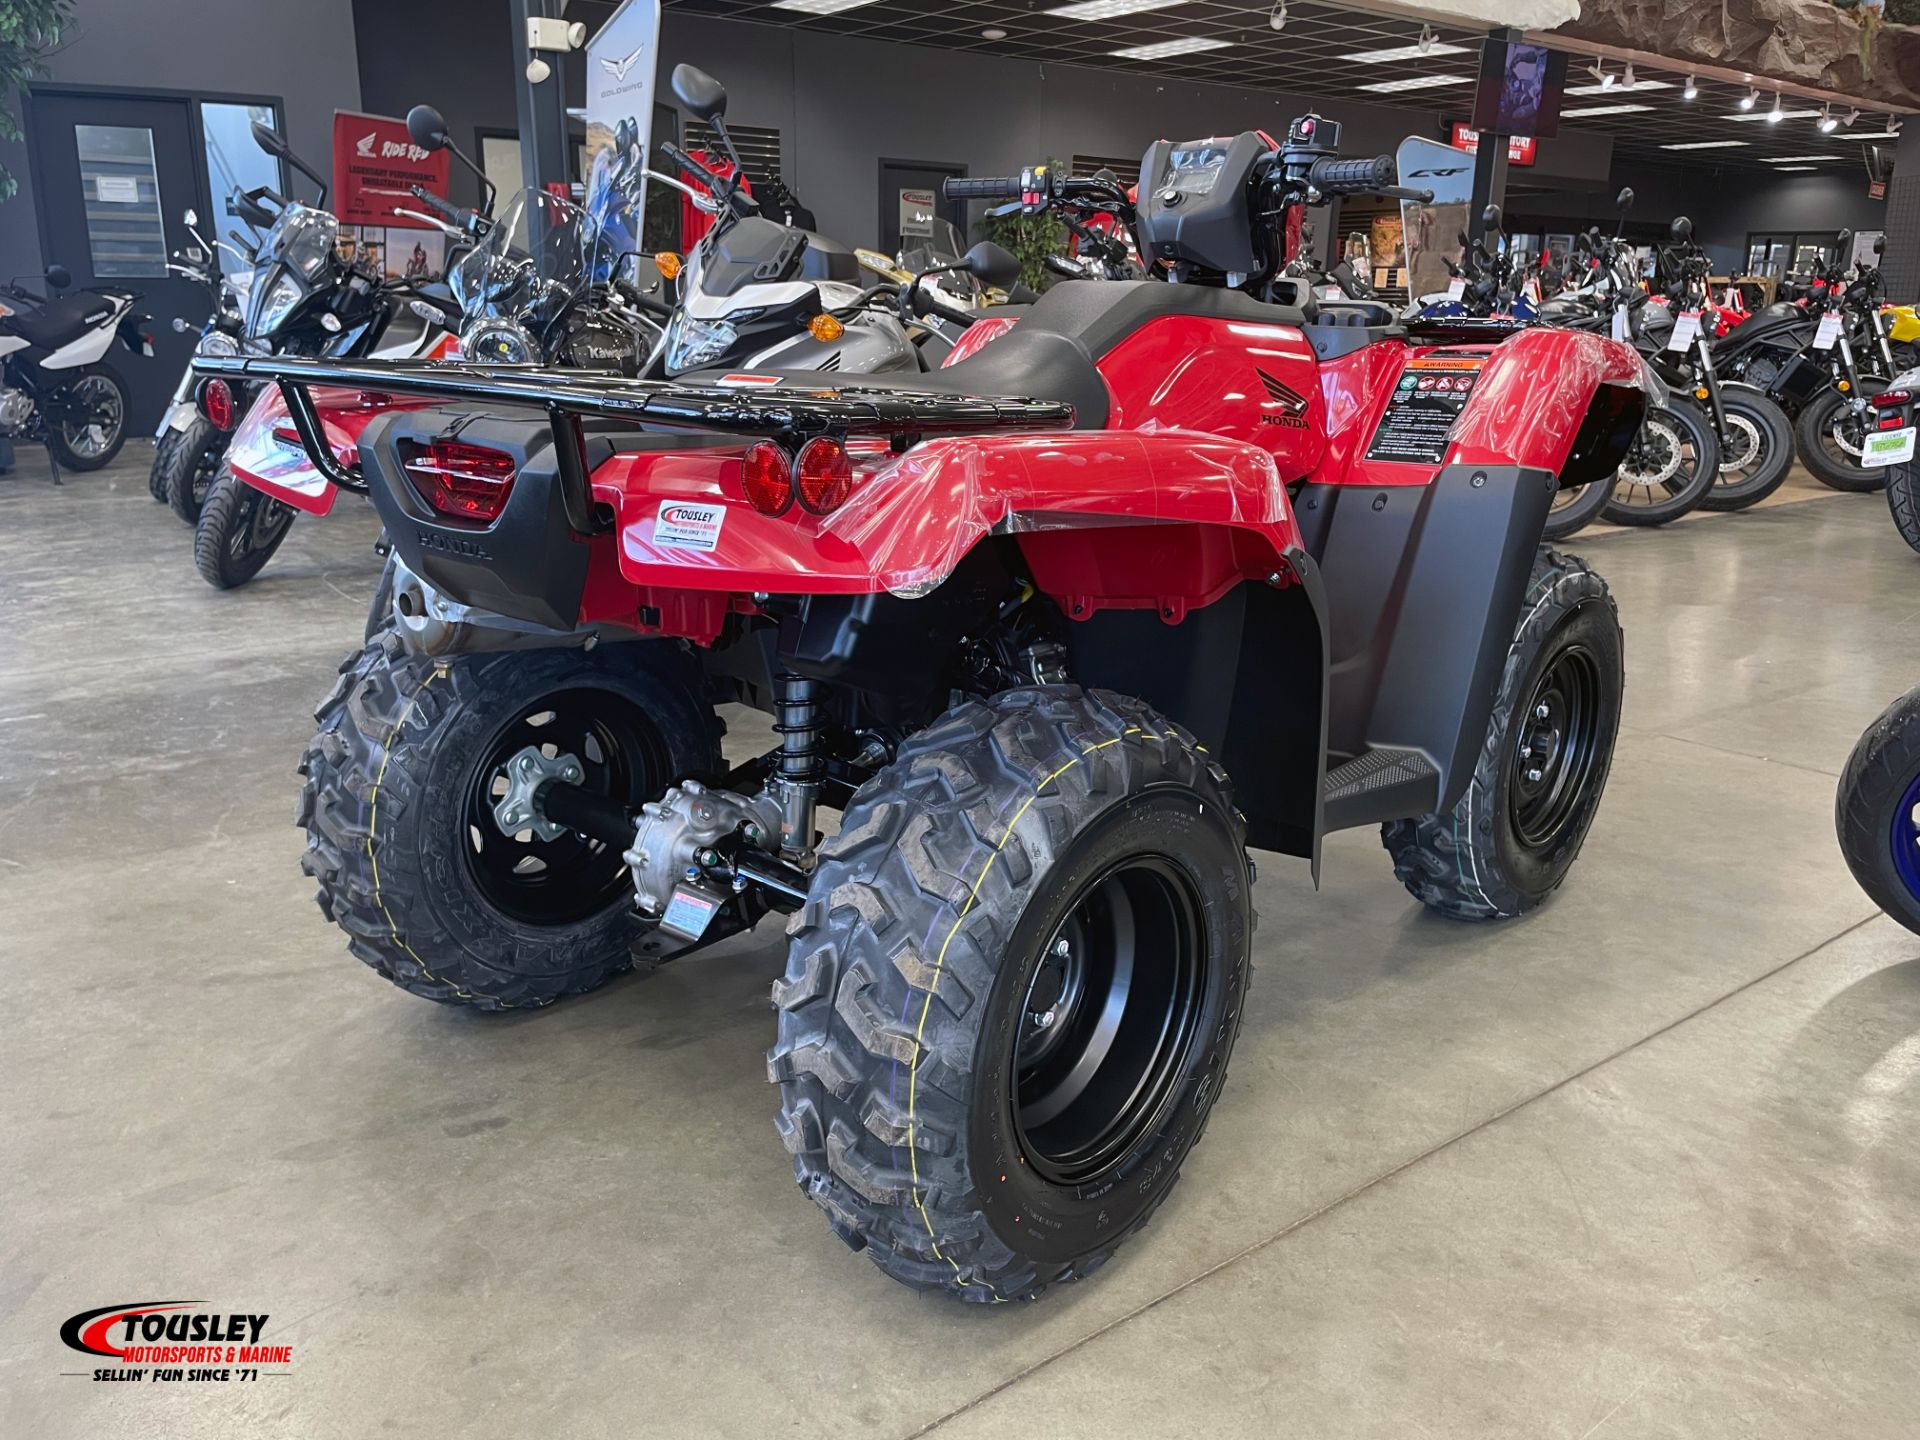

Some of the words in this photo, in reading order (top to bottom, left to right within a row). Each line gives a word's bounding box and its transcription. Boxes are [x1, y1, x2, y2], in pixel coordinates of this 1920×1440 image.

[1458, 128, 1480, 142] TOUS
[1509, 135, 1531, 149] ITORY
[381, 141, 408, 158] RIDE
[1261, 414, 1310, 430] HONDA
[675, 508, 716, 523] TOUSLEY
[417, 528, 493, 561] HONDA
